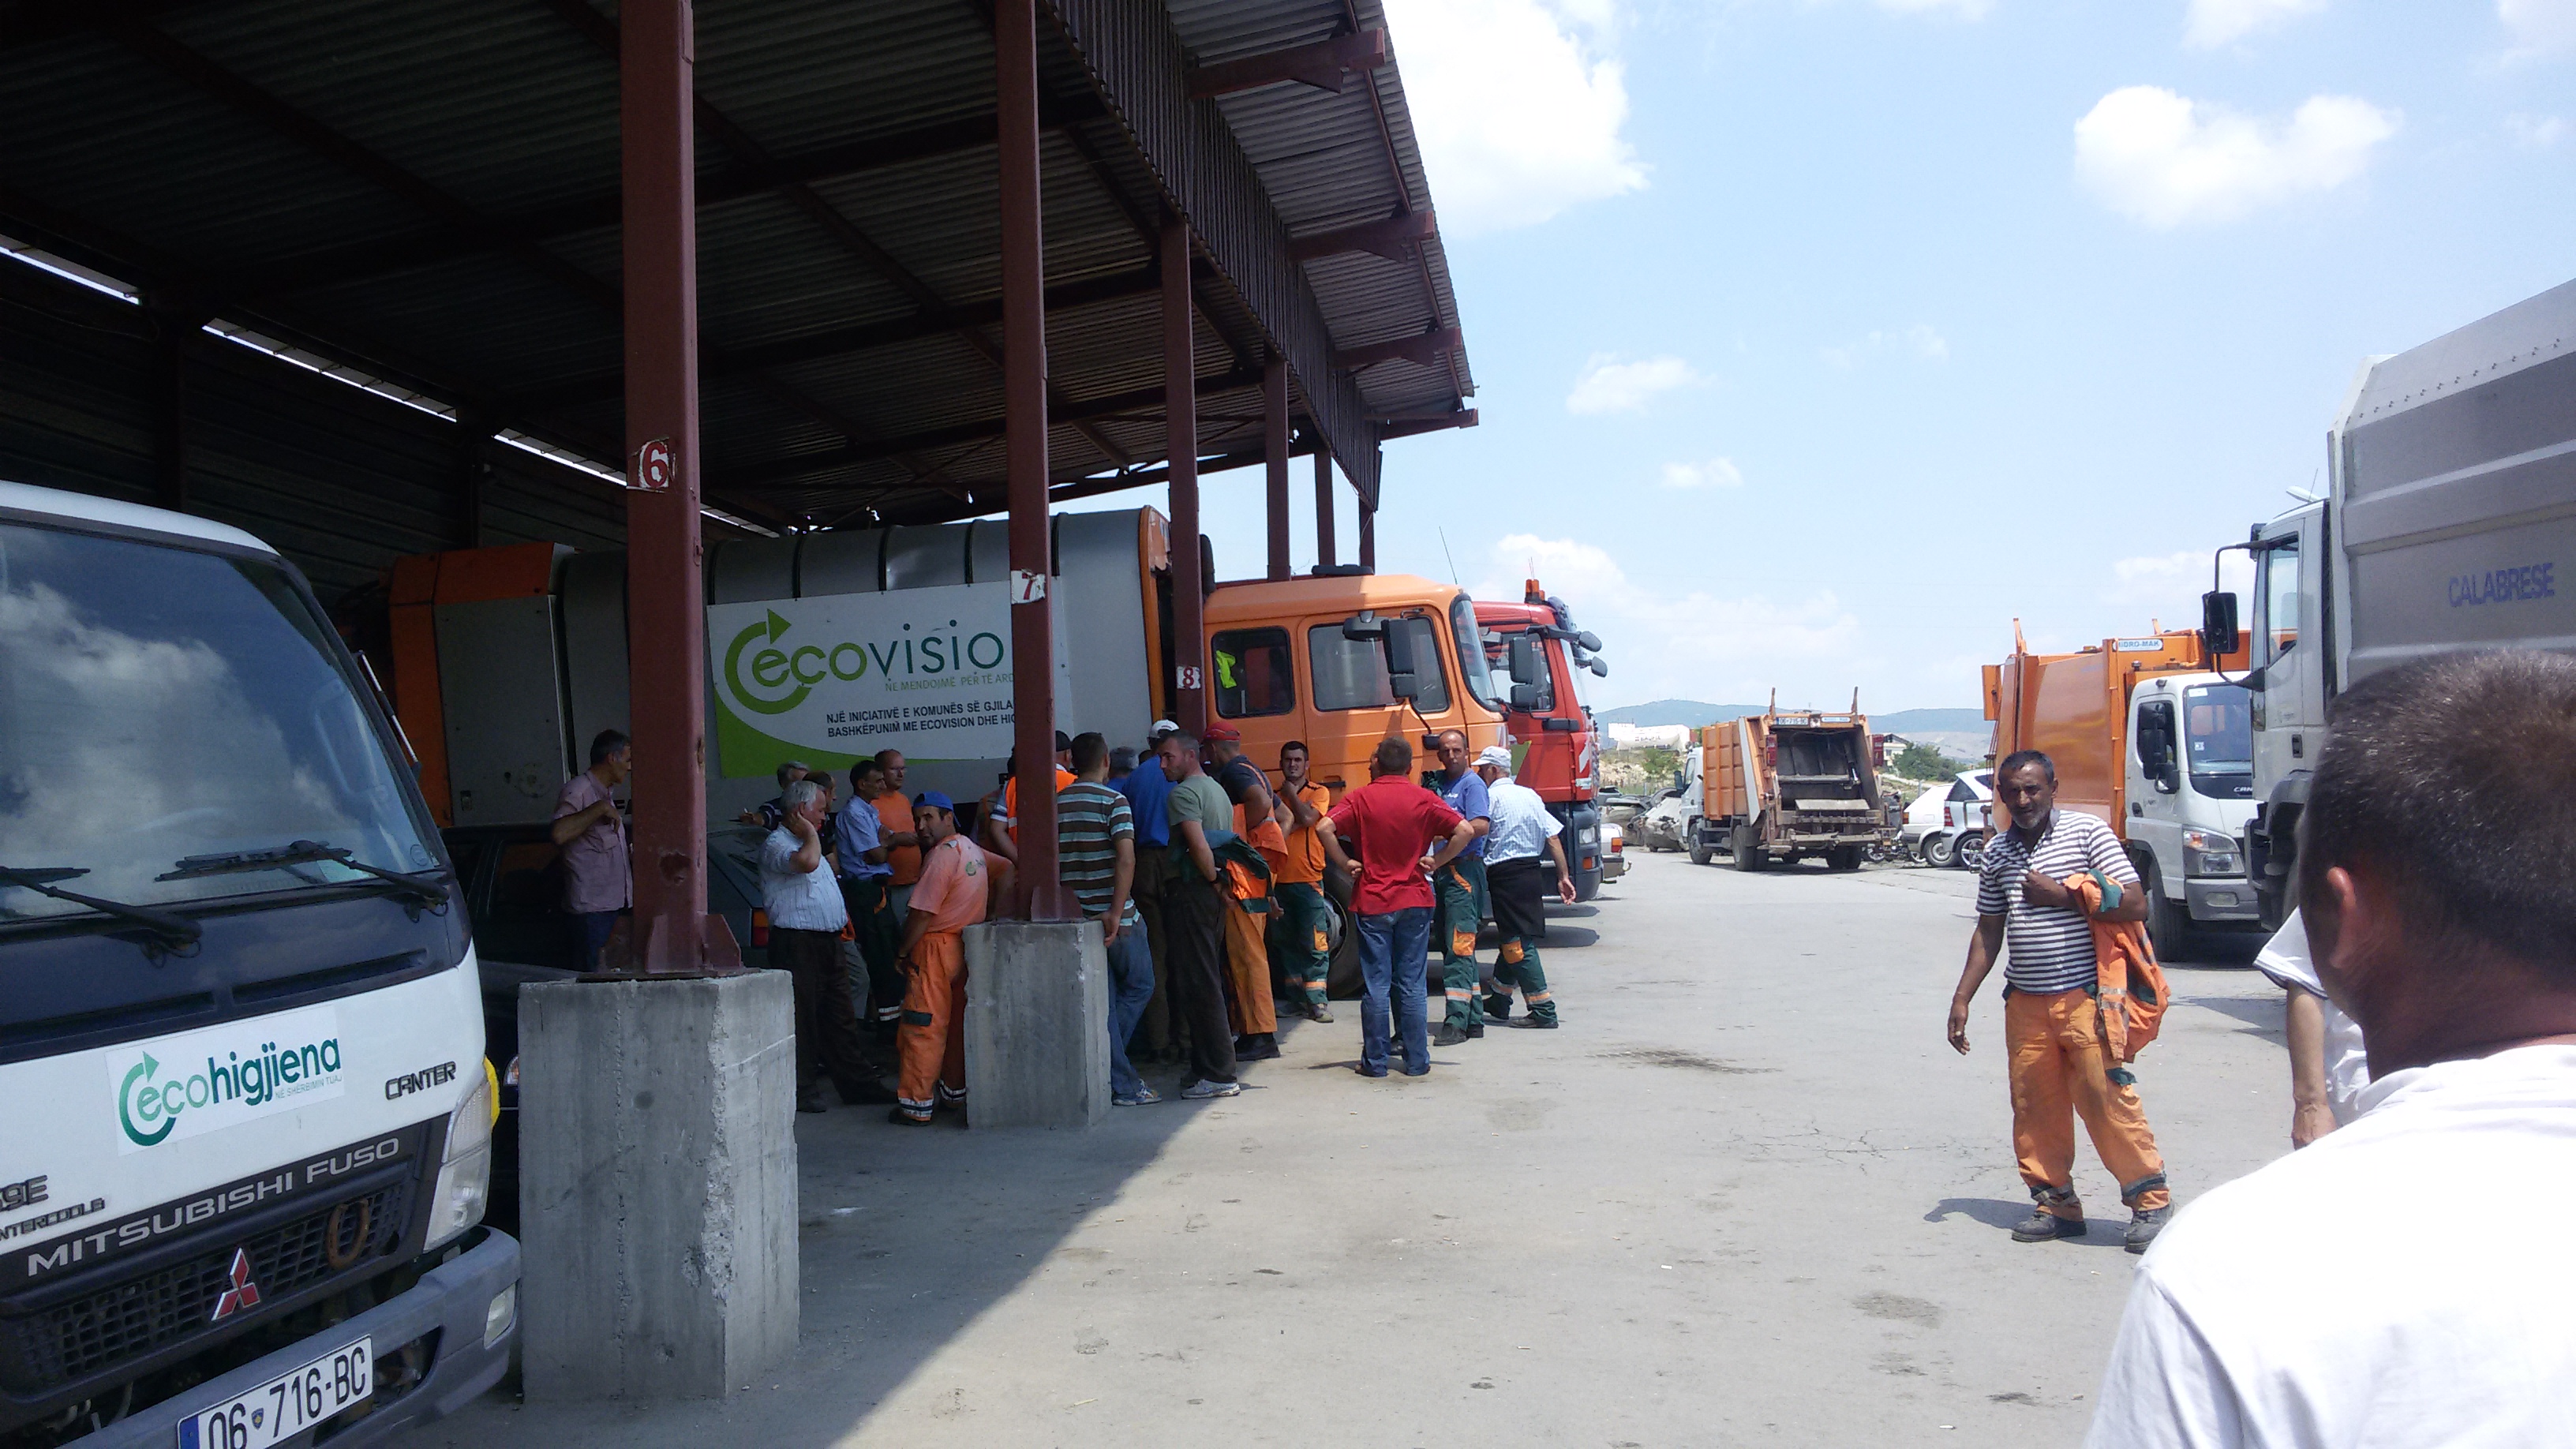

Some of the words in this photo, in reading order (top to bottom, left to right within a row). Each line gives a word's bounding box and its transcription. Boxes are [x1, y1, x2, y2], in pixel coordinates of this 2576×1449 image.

[642, 442, 668, 489] 6
[1021, 572, 1035, 600] 7
[2448, 562, 2555, 608] CALABRESE
[752, 620, 1005, 687] ecovisio
[1182, 667, 1194, 687] 8
[826, 710, 845, 724] NJË
[849, 706, 900, 722] INICIATIVË
[903, 708, 910, 717] E
[913, 702, 964, 717] KOMUNËS
[967, 700, 980, 713] SË
[984, 700, 1013, 712] GJILA
[828, 721, 900, 737] BASHKËPUNIM
[904, 721, 918, 732] ME
[920, 717, 975, 730] ECOVISION
[977, 715, 998, 726] DHE
[137, 1038, 341, 1121] ecohigjiena
[385, 1061, 456, 1100] CANTER
[0, 1174, 49, 1211] 9E
[28, 1172, 293, 1277] MITSUBISHI
[306, 1137, 399, 1184] FUSO
[269, 1346, 365, 1438] 716-BC
